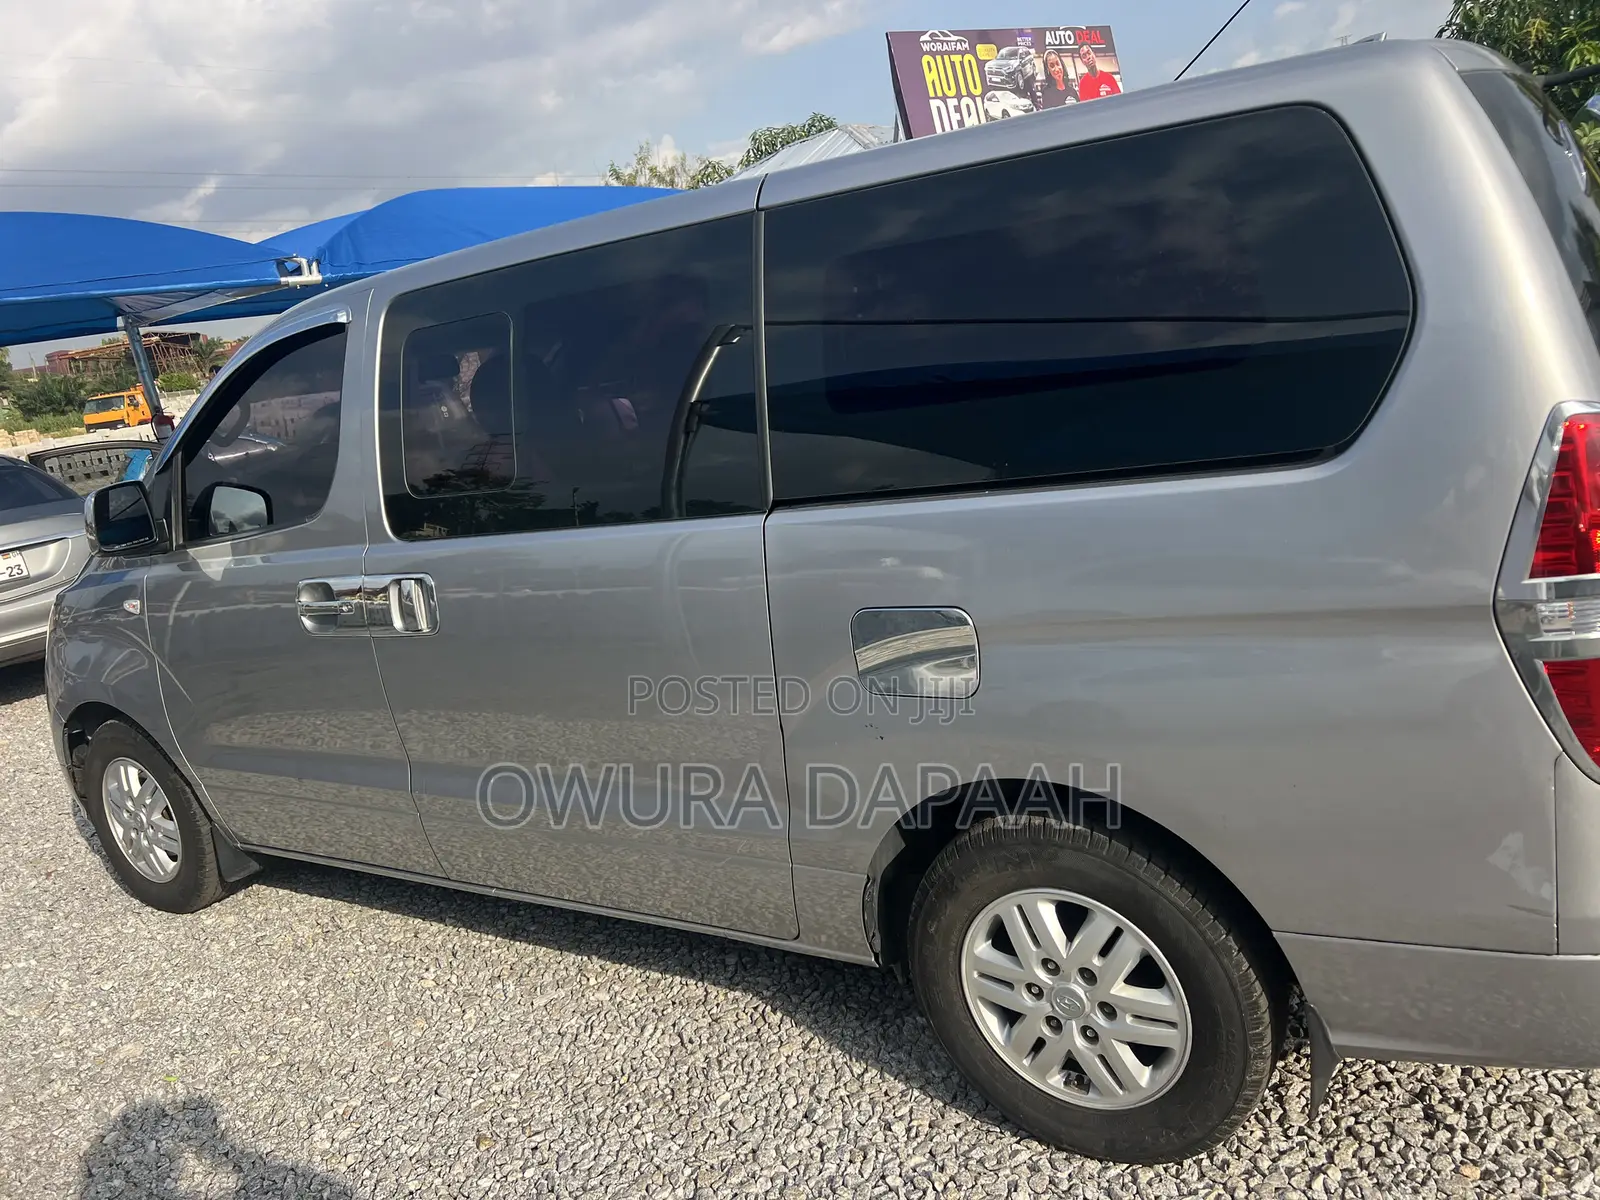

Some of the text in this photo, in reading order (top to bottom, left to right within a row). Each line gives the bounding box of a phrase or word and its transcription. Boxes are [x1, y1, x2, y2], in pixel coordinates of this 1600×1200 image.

[1045, 29, 1106, 45] AUTO DEAL
[920, 41, 970, 52] WORAIFAM
[921, 54, 983, 97] AUTO
